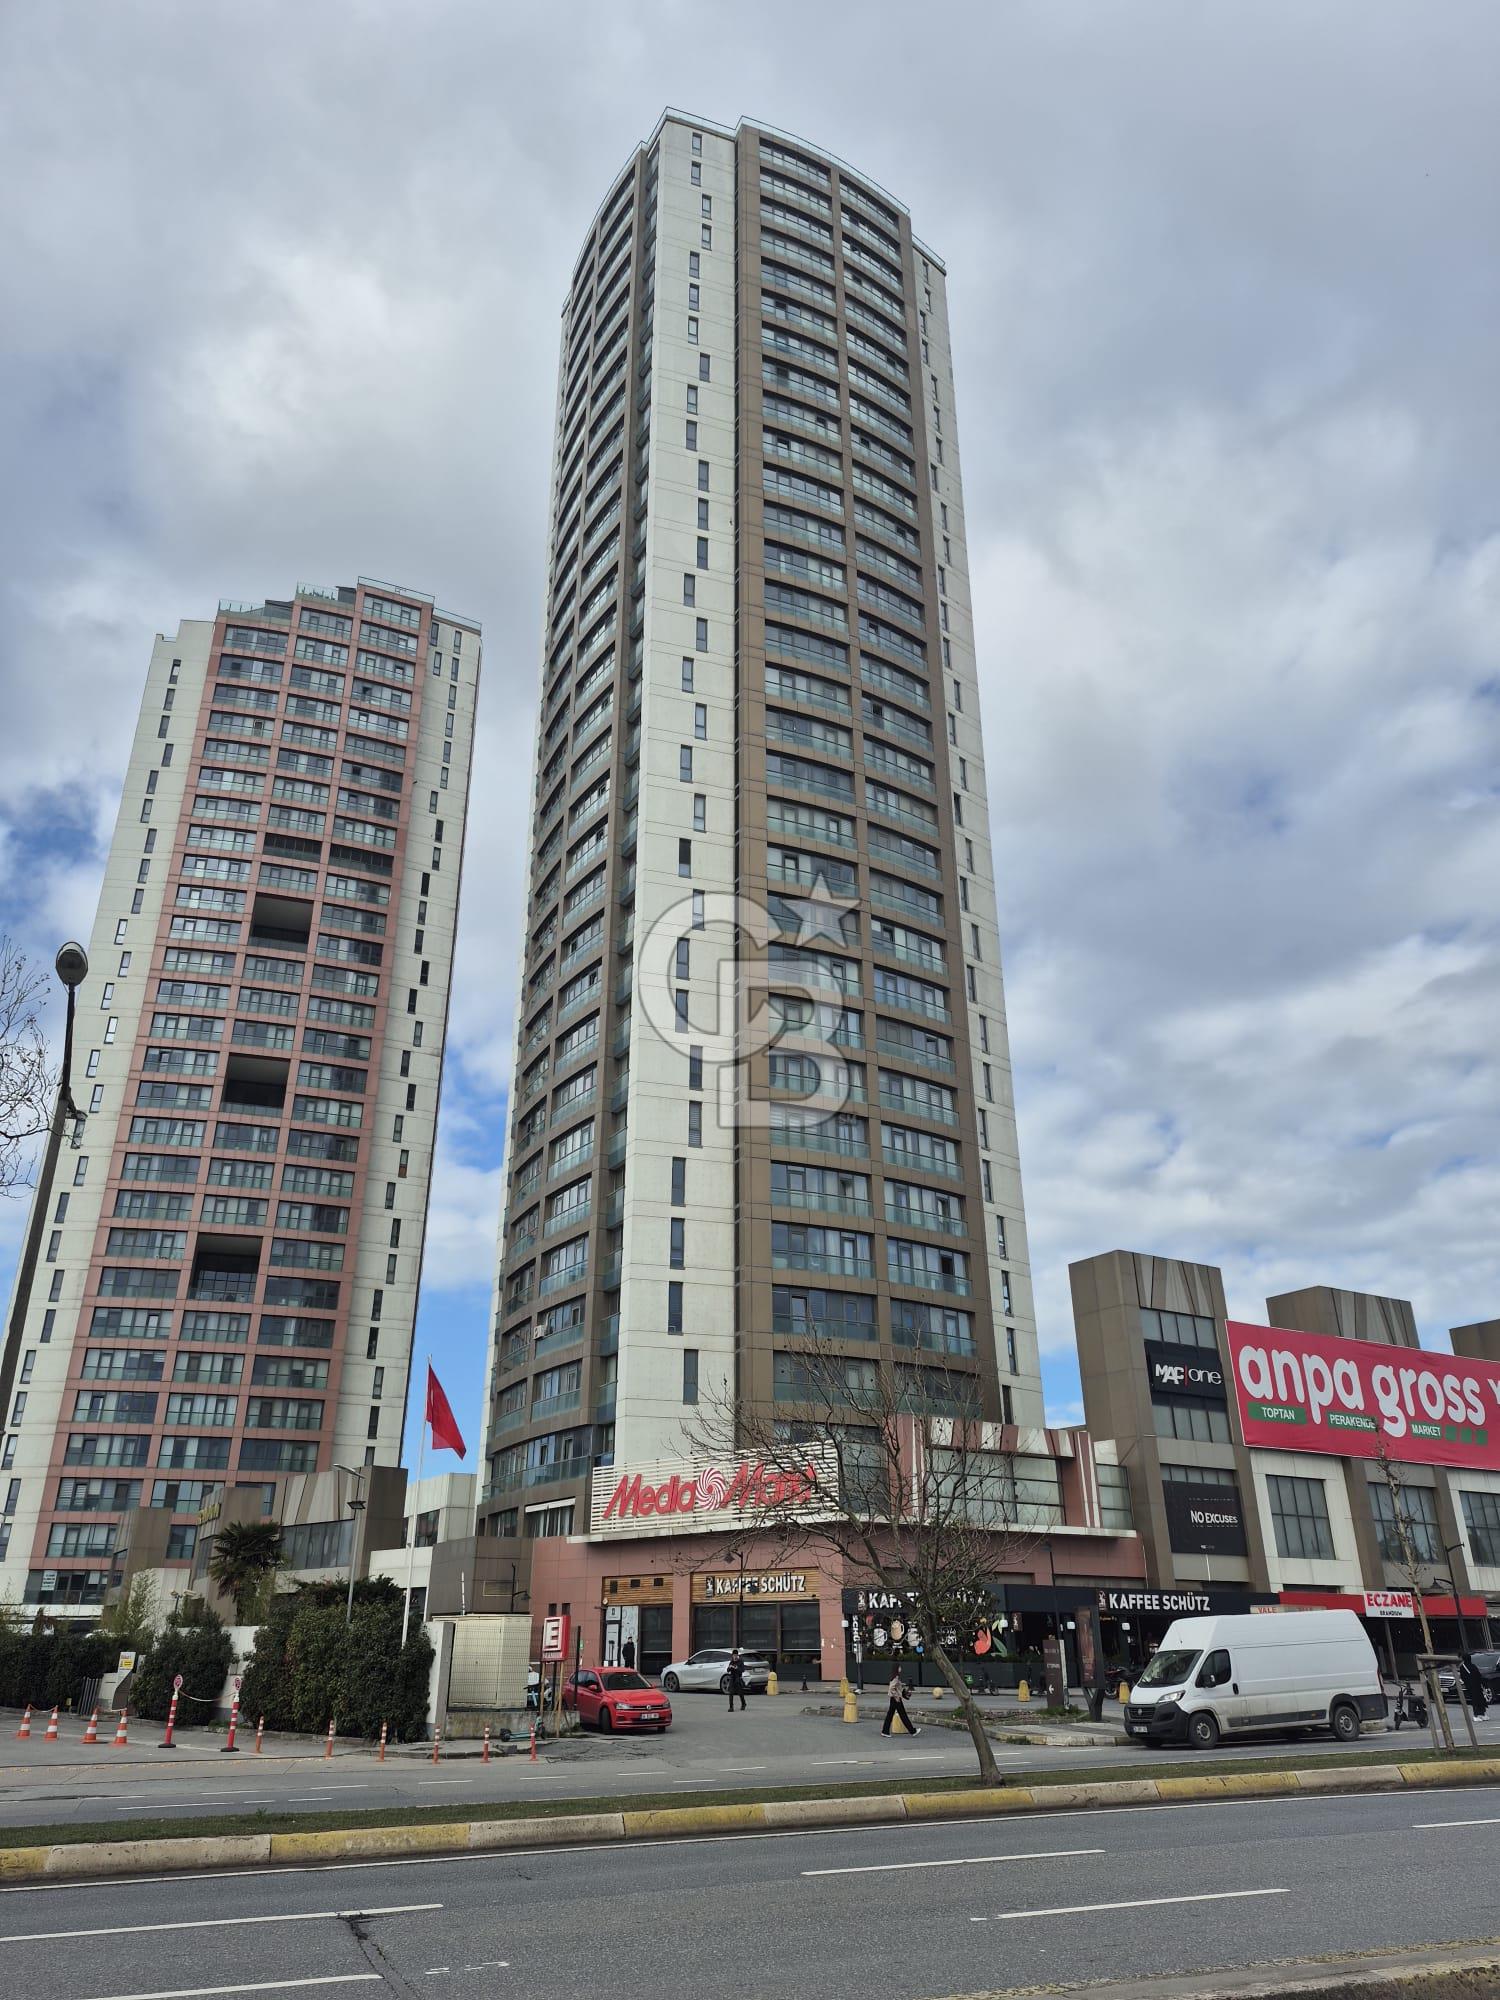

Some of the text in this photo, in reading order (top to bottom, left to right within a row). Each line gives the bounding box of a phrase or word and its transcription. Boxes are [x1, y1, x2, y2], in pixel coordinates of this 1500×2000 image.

[1188, 1368, 1222, 1385] one
[1238, 1345, 1365, 1425] anpa
[1371, 1363, 1486, 1438] gross
[1261, 1406, 1295, 1421] TOPTAN
[1329, 1413, 1376, 1429] PERAKENDE
[1411, 1423, 1441, 1437] MARKET
[602, 1473, 696, 1519] Media
[1190, 1510, 1239, 1524] NO EXCUSES
[761, 1572, 806, 1593] SCHÜTZ
[1109, 1590, 1211, 1611] KAFFEE SCHÜTZ
[1366, 1592, 1413, 1608] ECZANE
[545, 1621, 559, 1647] E
